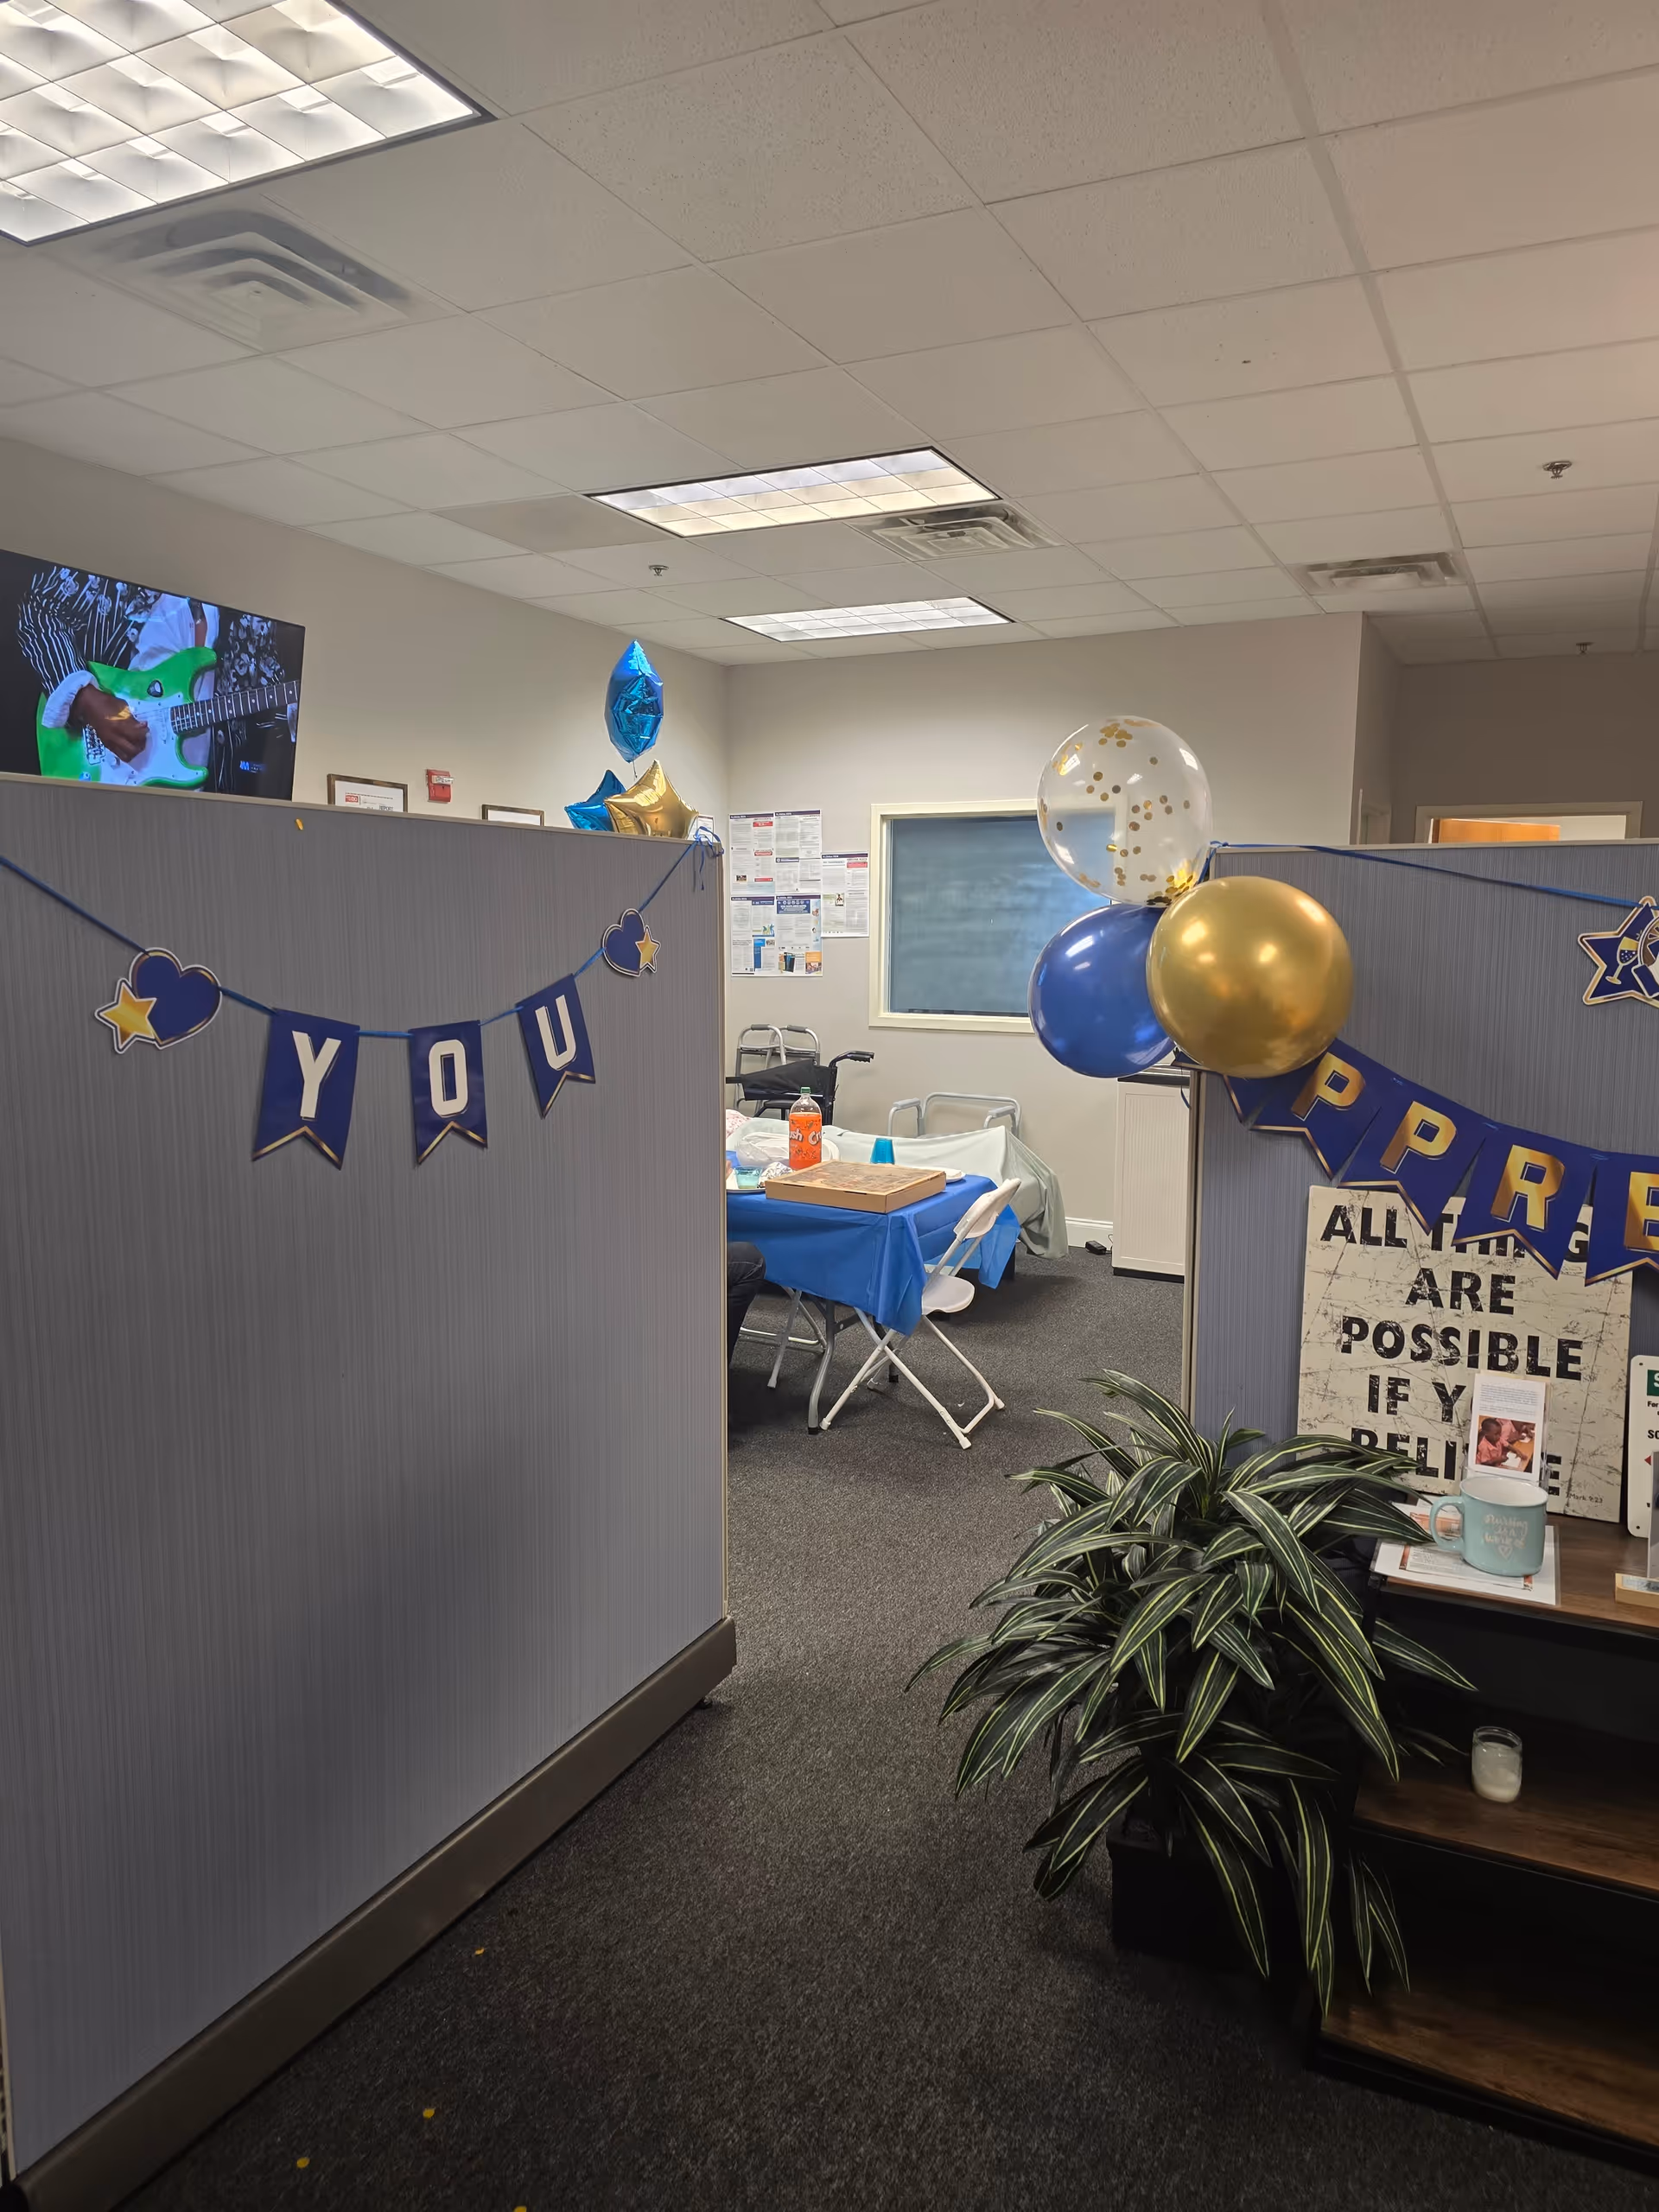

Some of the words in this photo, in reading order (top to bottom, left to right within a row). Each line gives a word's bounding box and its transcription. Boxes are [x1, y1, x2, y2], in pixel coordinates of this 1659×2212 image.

[291, 994, 577, 1122] YOU
[1319, 1205, 1408, 1249] ALL
[1405, 1267, 1516, 1315] ARE
[1340, 1314, 1583, 1382] POSSIBLE
[1367, 1374, 1410, 1415] IF
